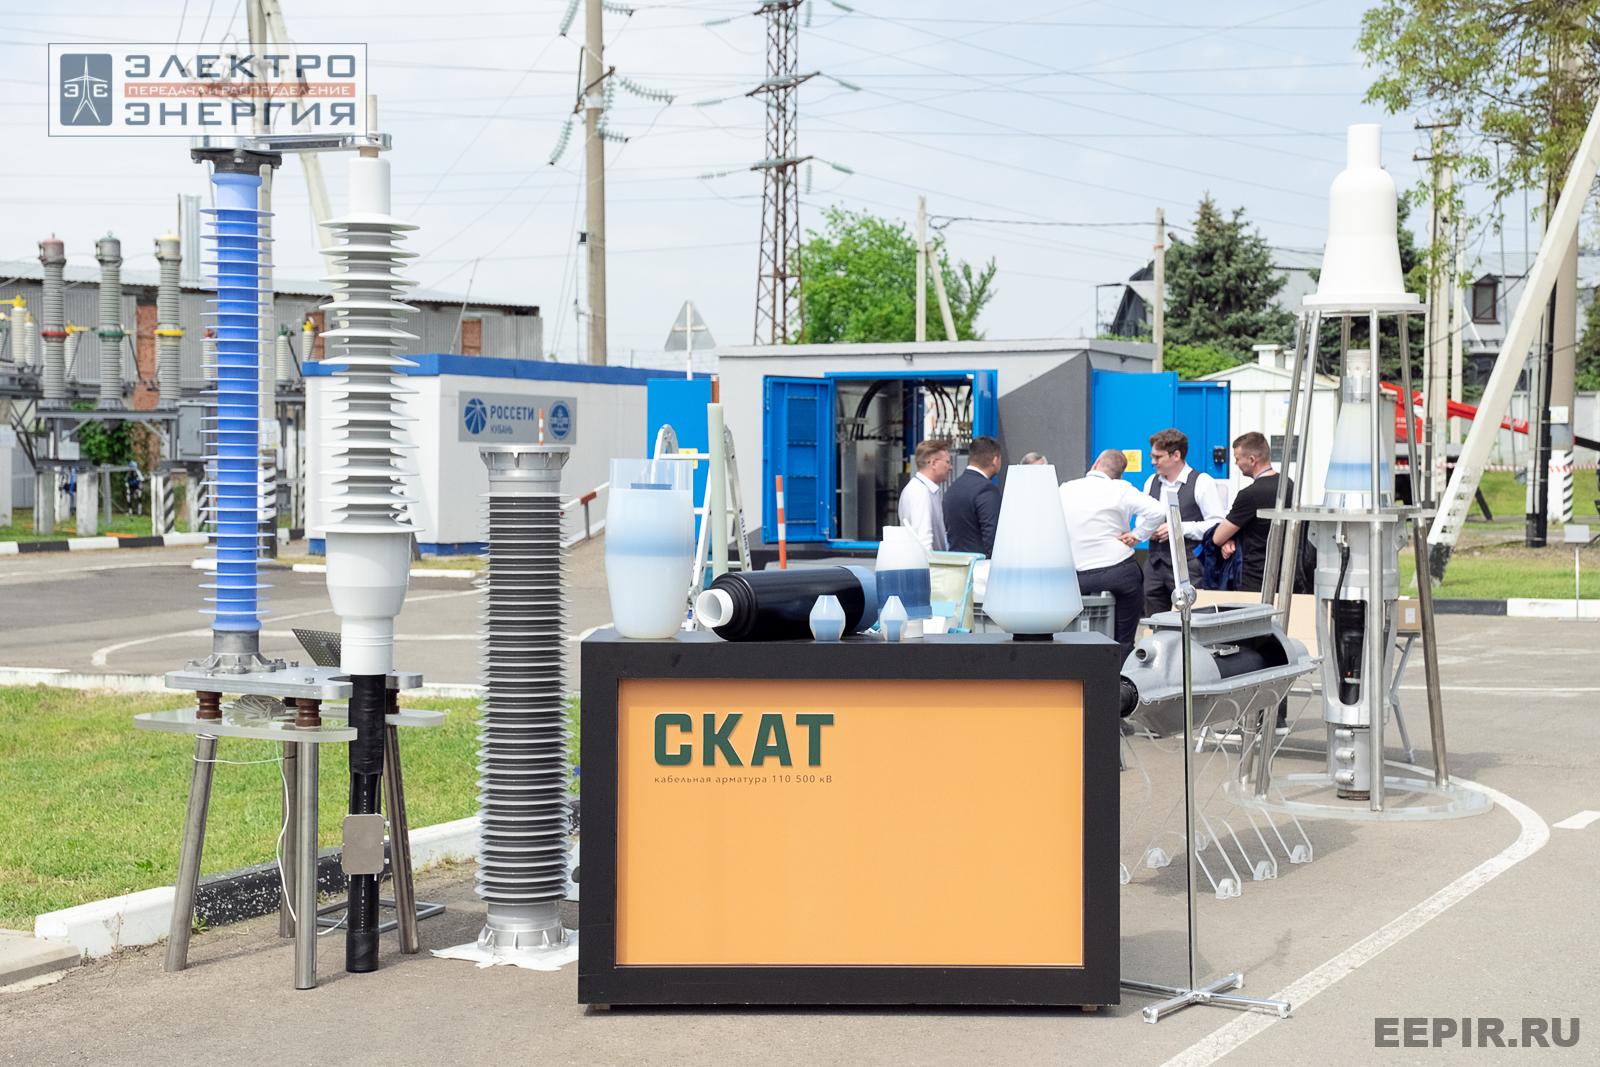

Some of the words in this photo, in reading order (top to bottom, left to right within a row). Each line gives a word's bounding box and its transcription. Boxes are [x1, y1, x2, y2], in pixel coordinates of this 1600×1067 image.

[490, 405, 534, 420] РОССЕТИ
[654, 713, 835, 767] СКАТ
[654, 774, 712, 784] кабельная
[715, 776, 768, 786] арматура
[772, 774, 791, 784] 110
[796, 774, 816, 784] 500
